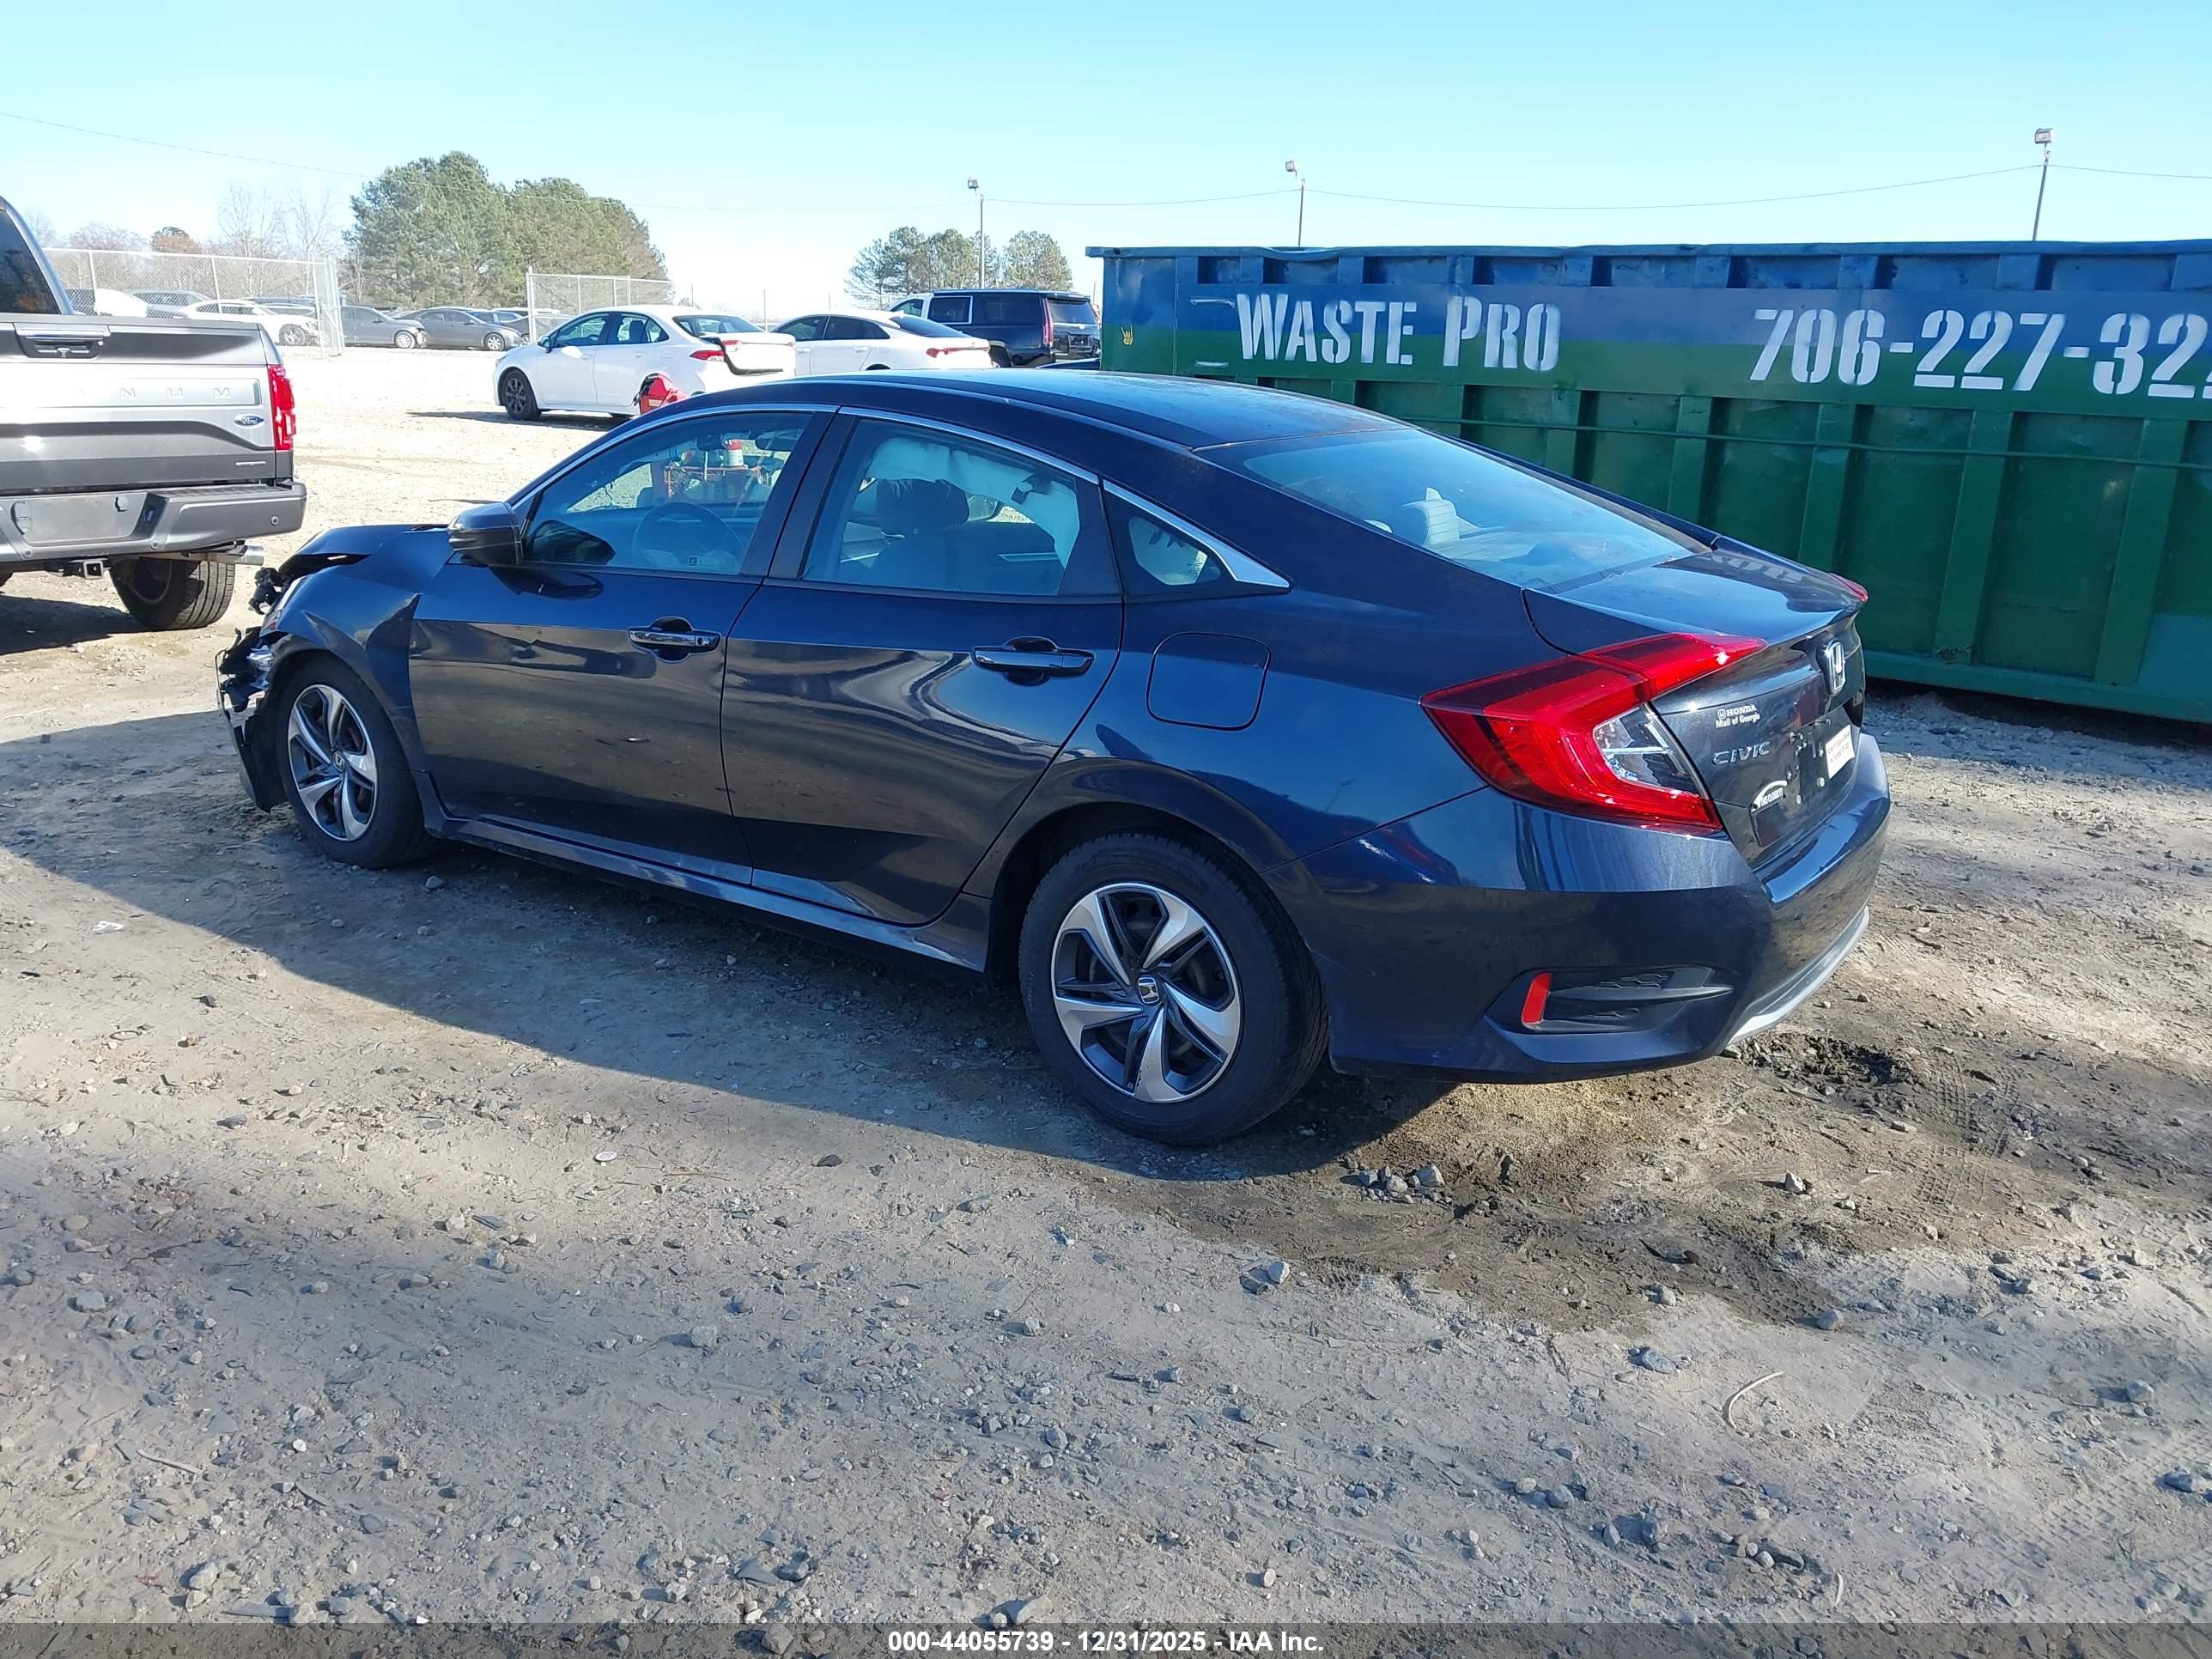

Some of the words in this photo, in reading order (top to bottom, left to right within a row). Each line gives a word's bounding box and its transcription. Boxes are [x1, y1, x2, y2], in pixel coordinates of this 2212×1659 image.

[1750, 309, 2212, 399] 706-227-32
[1716, 719, 1731, 728] Mall
[1732, 716, 1739, 725] of
[1740, 712, 1760, 723] Georgia
[1726, 704, 1757, 717] HONDA
[1713, 741, 1770, 765] CIVIC
